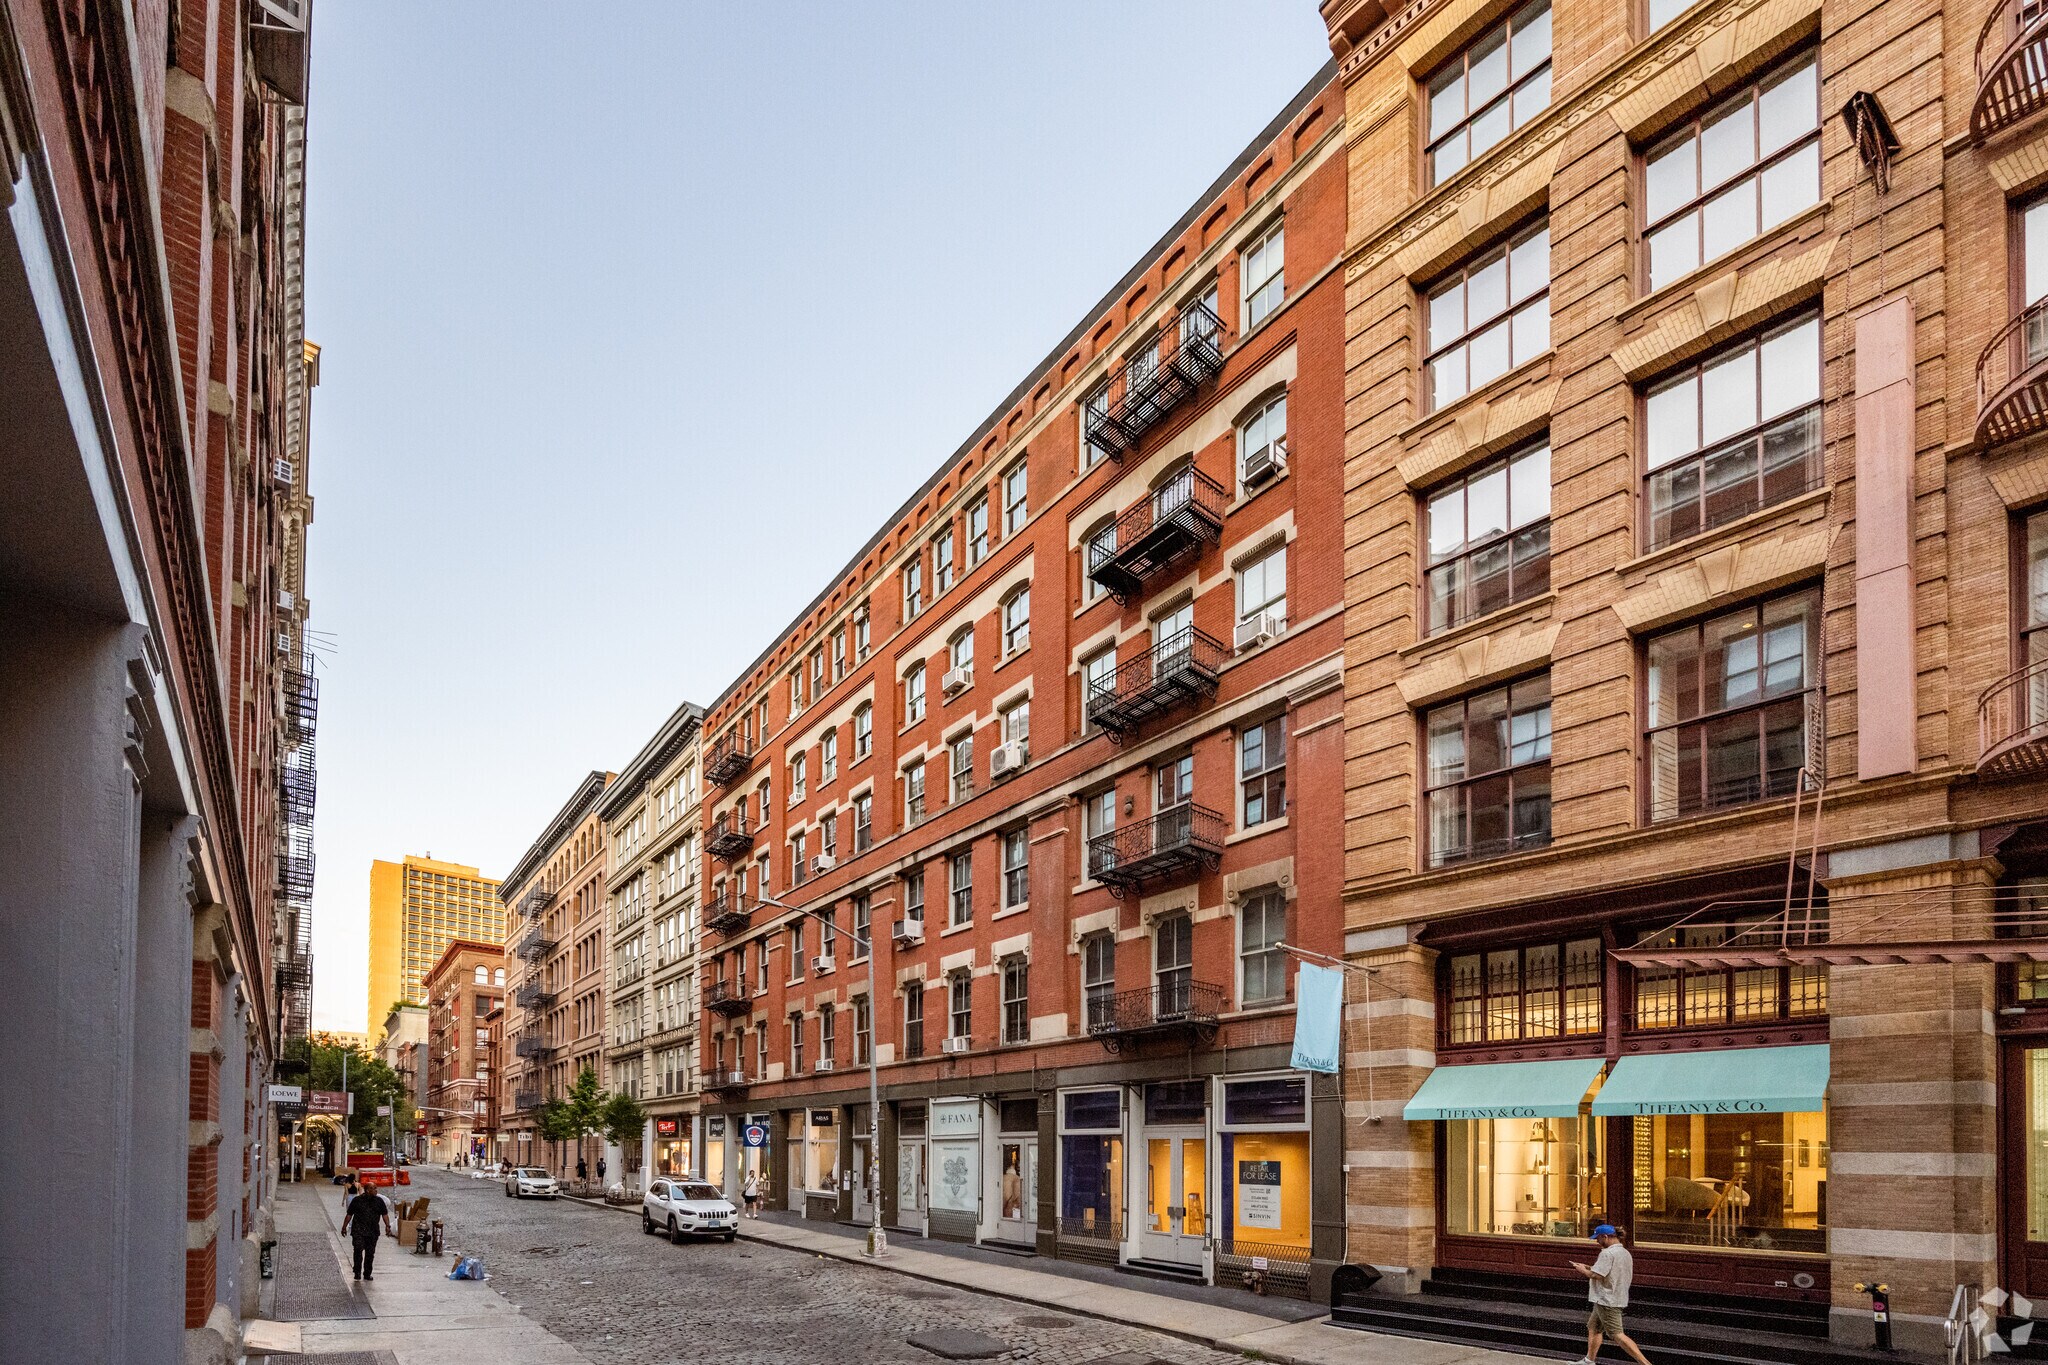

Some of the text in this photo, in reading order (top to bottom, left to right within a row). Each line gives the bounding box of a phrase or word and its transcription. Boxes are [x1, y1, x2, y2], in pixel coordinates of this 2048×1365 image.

[1635, 1100, 1767, 1113] TIFFANY & CO.
[1437, 1107, 1537, 1118] TIFFANY & CO.
[948, 1113, 973, 1123] FANA
[1242, 1171, 1277, 1181] FOR LEASE
